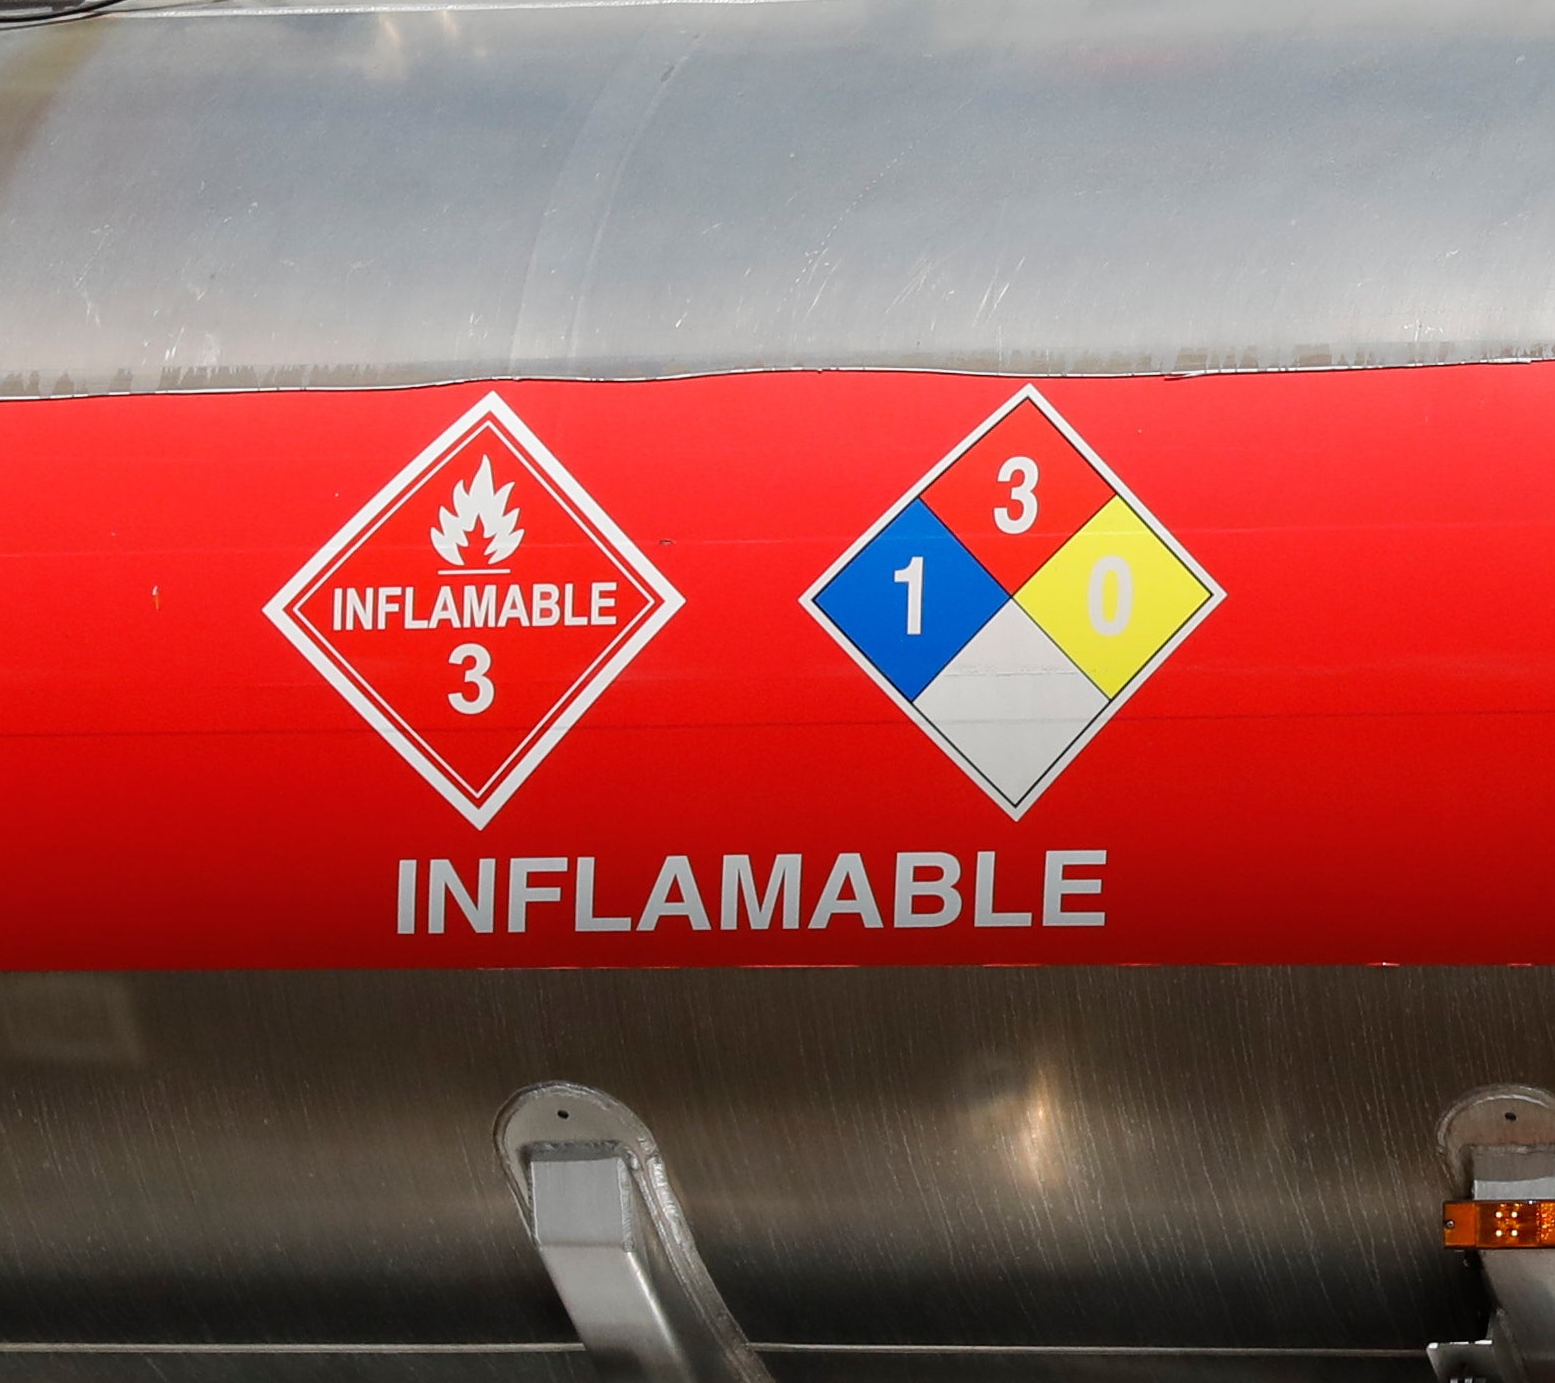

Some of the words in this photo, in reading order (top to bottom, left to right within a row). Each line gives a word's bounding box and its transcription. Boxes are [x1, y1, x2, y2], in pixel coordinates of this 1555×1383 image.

[994, 456, 1040, 536] 3
[332, 581, 618, 631] INFLAMABLE
[893, 556, 926, 636] 1
[1086, 555, 1137, 638] 0
[448, 643, 496, 716] 3
[396, 849, 1108, 936] INFLAMABLE
